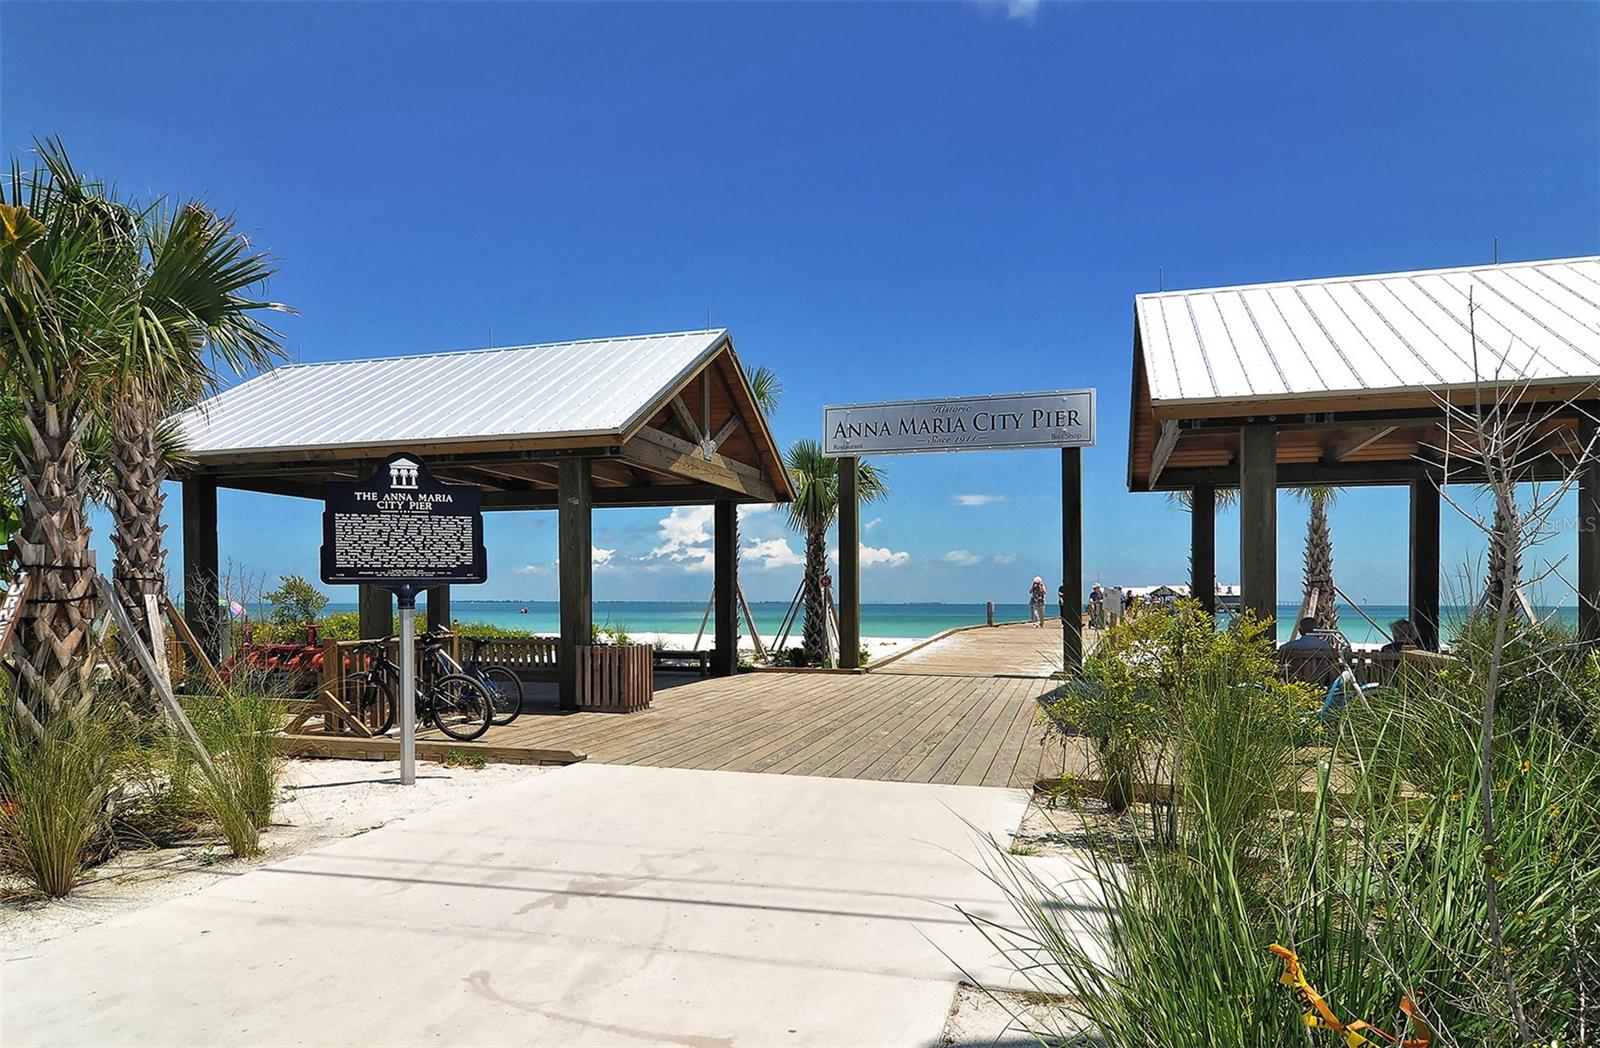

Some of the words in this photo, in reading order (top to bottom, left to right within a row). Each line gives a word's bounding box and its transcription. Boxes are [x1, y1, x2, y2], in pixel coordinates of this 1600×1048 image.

[932, 404, 971, 413] Historic
[833, 420, 892, 439] ANNA
[898, 411, 966, 436] MARIA
[972, 412, 1025, 432] CITY
[1031, 409, 1082, 428] PIER
[928, 434, 951, 444] Since
[354, 491, 378, 501] THE
[382, 493, 413, 502] ANNA
[418, 493, 453, 503] MARIA
[376, 500, 405, 510] CITY
[409, 501, 433, 510] PIER
